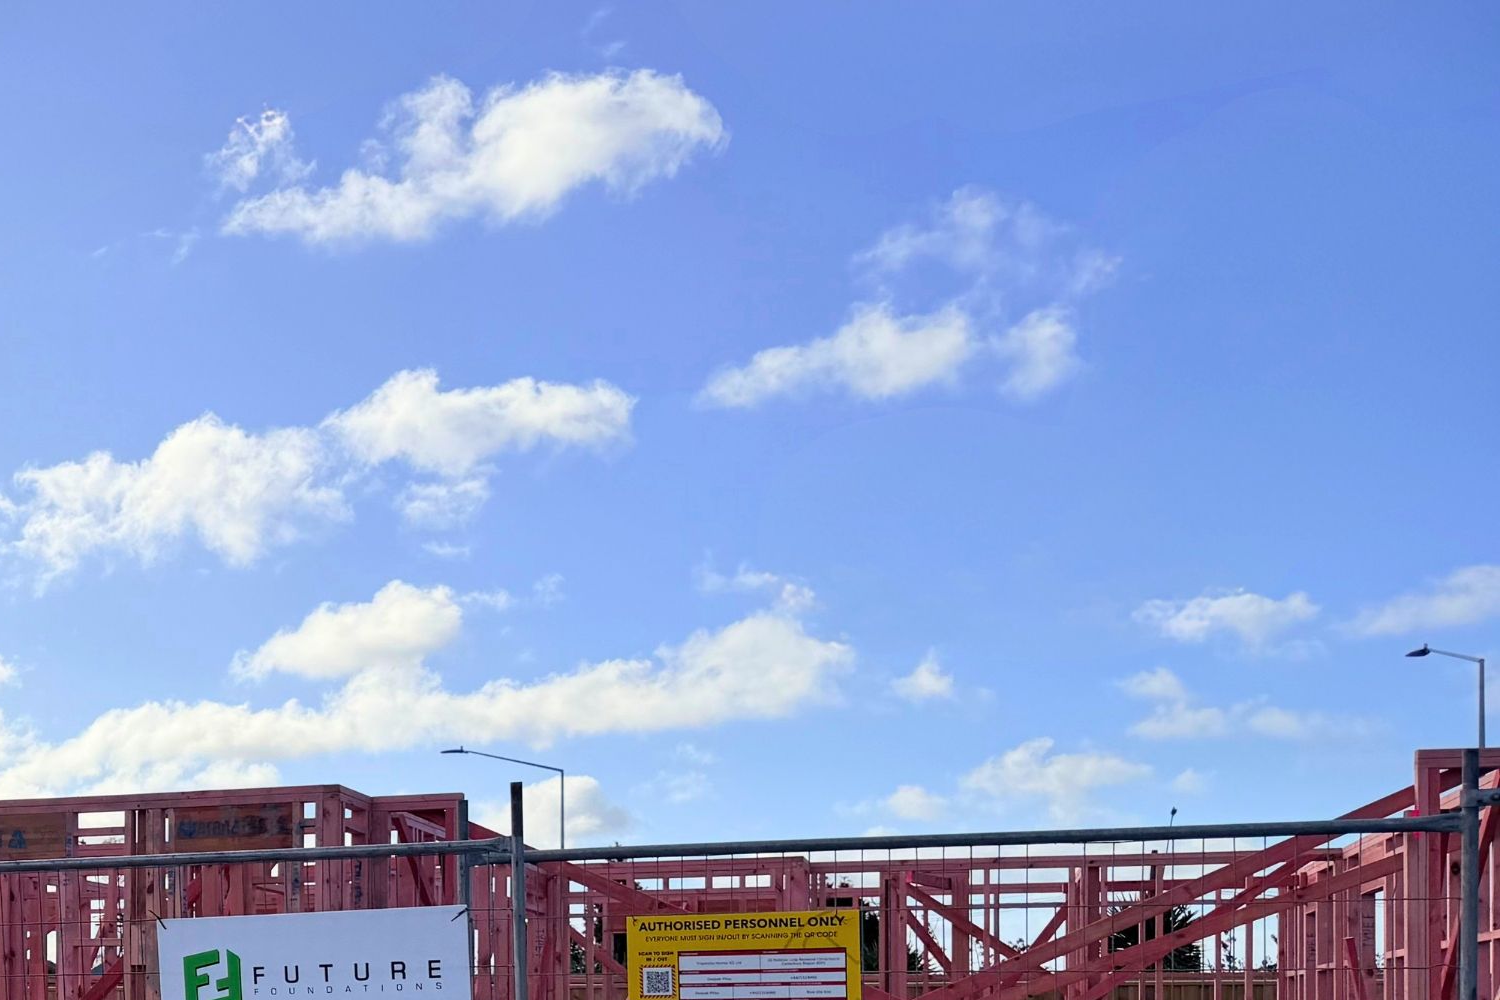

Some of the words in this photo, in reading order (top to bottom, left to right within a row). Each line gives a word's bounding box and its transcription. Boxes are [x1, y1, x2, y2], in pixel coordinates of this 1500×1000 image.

[639, 920, 721, 932] AUTHORISED
[724, 917, 805, 929] PERSONNEL
[807, 915, 845, 927] ONLY
[716, 933, 740, 941] IN/OUT
[742, 932, 749, 940] BY
[751, 932, 788, 940] SCANNING
[252, 959, 442, 985] FUTURE
[254, 982, 442, 996] FOUNDATIONS
